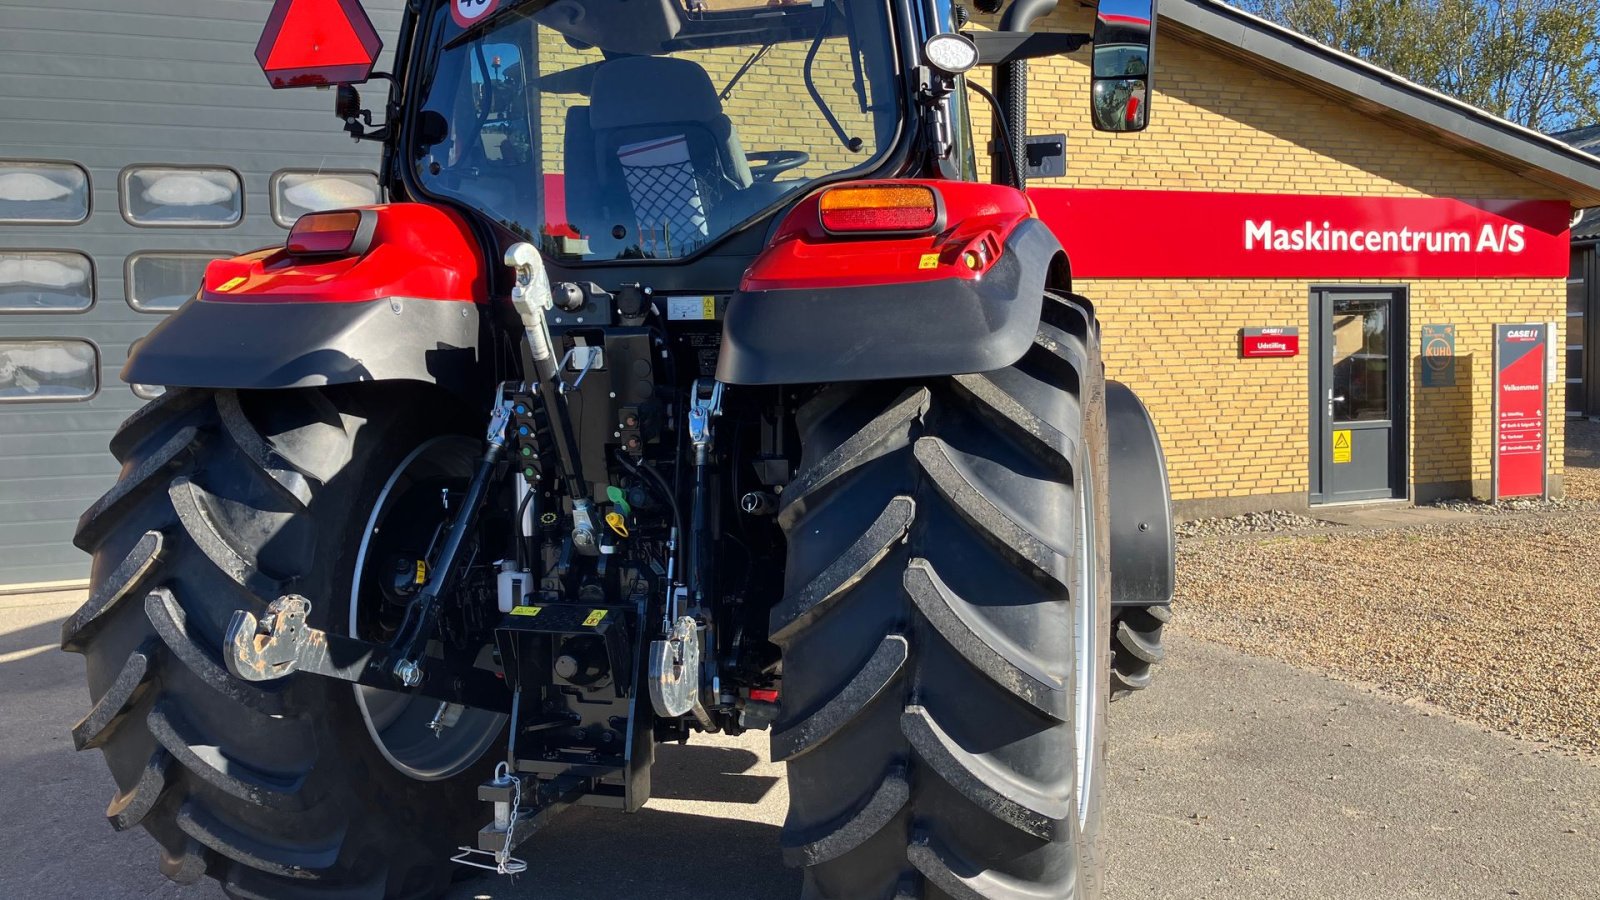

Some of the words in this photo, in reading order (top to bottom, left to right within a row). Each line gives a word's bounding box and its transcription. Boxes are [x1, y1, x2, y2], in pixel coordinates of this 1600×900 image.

[1244, 219, 1470, 252] Maskincentrum
[1475, 223, 1525, 252] A/S
[1507, 330, 1530, 338] CASE
[1257, 342, 1286, 350] Udstilling
[1503, 384, 1539, 392] Velkommen
